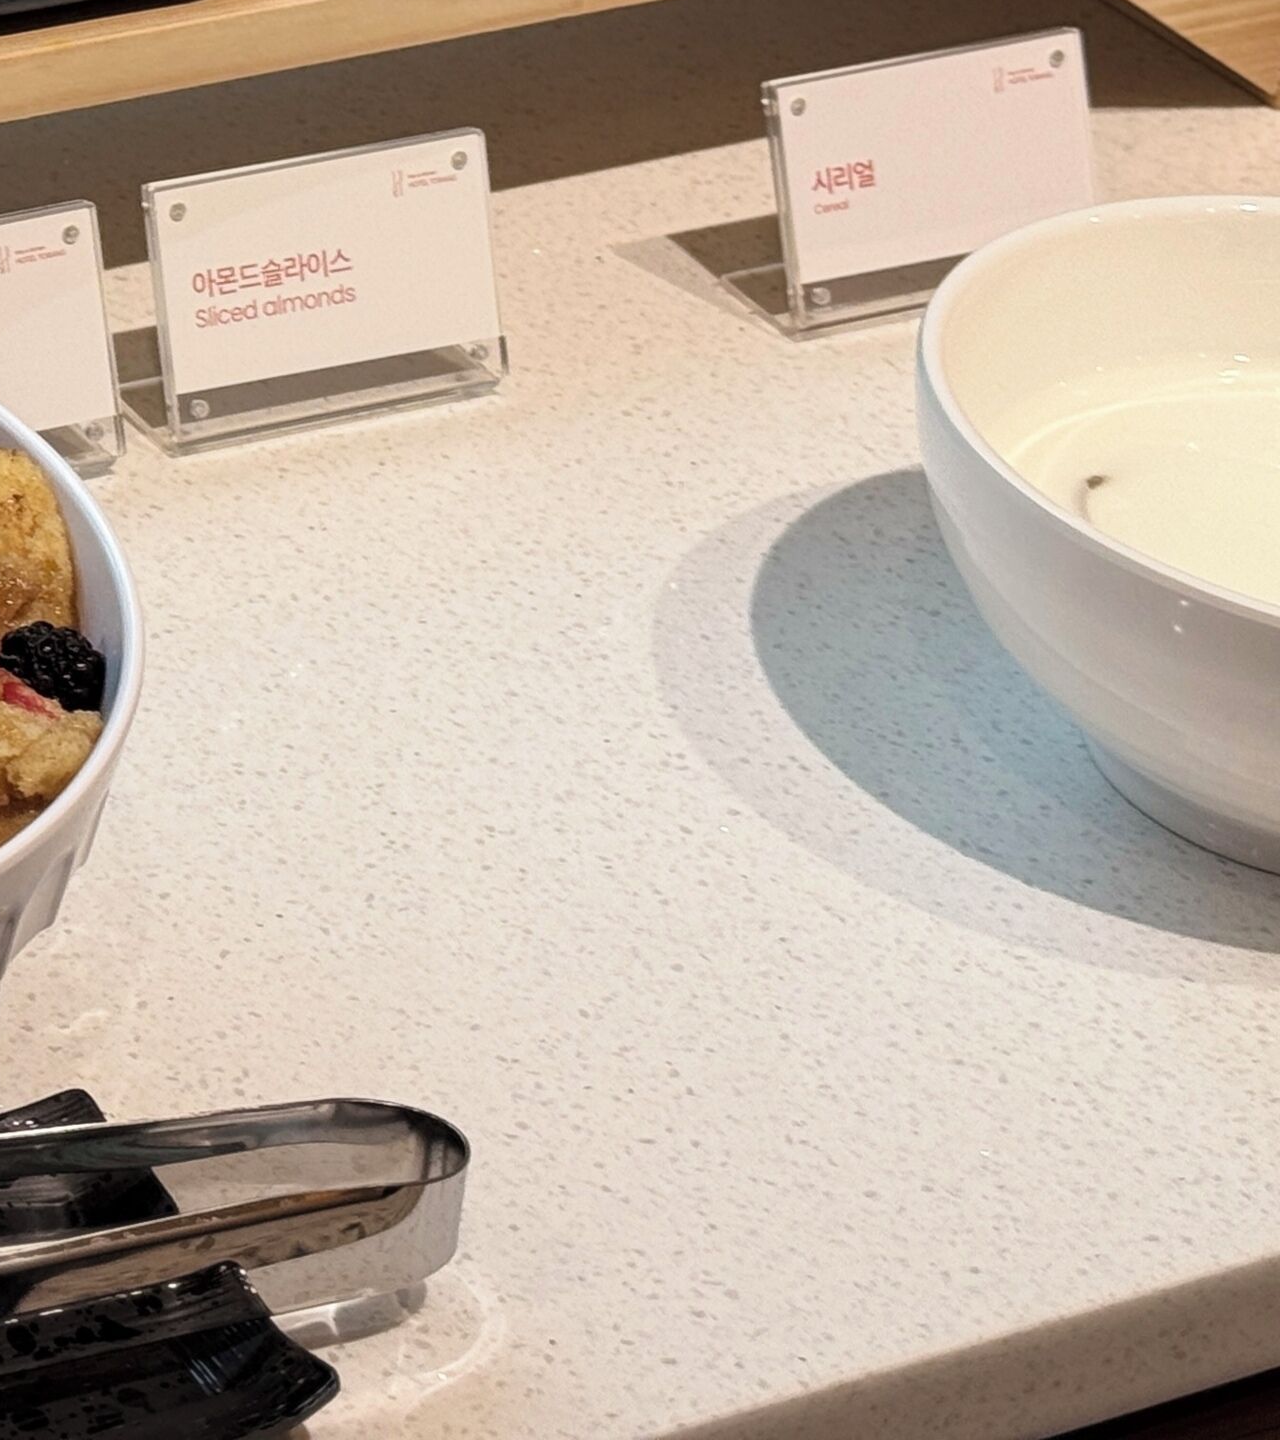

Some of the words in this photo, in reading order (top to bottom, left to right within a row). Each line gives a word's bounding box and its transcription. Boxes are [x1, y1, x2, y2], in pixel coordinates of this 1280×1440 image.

[811, 159, 875, 194] 시리얼
[192, 248, 354, 298] 아몬드슬라이스
[195, 299, 258, 328] Sliced
[262, 284, 357, 317] almonds
